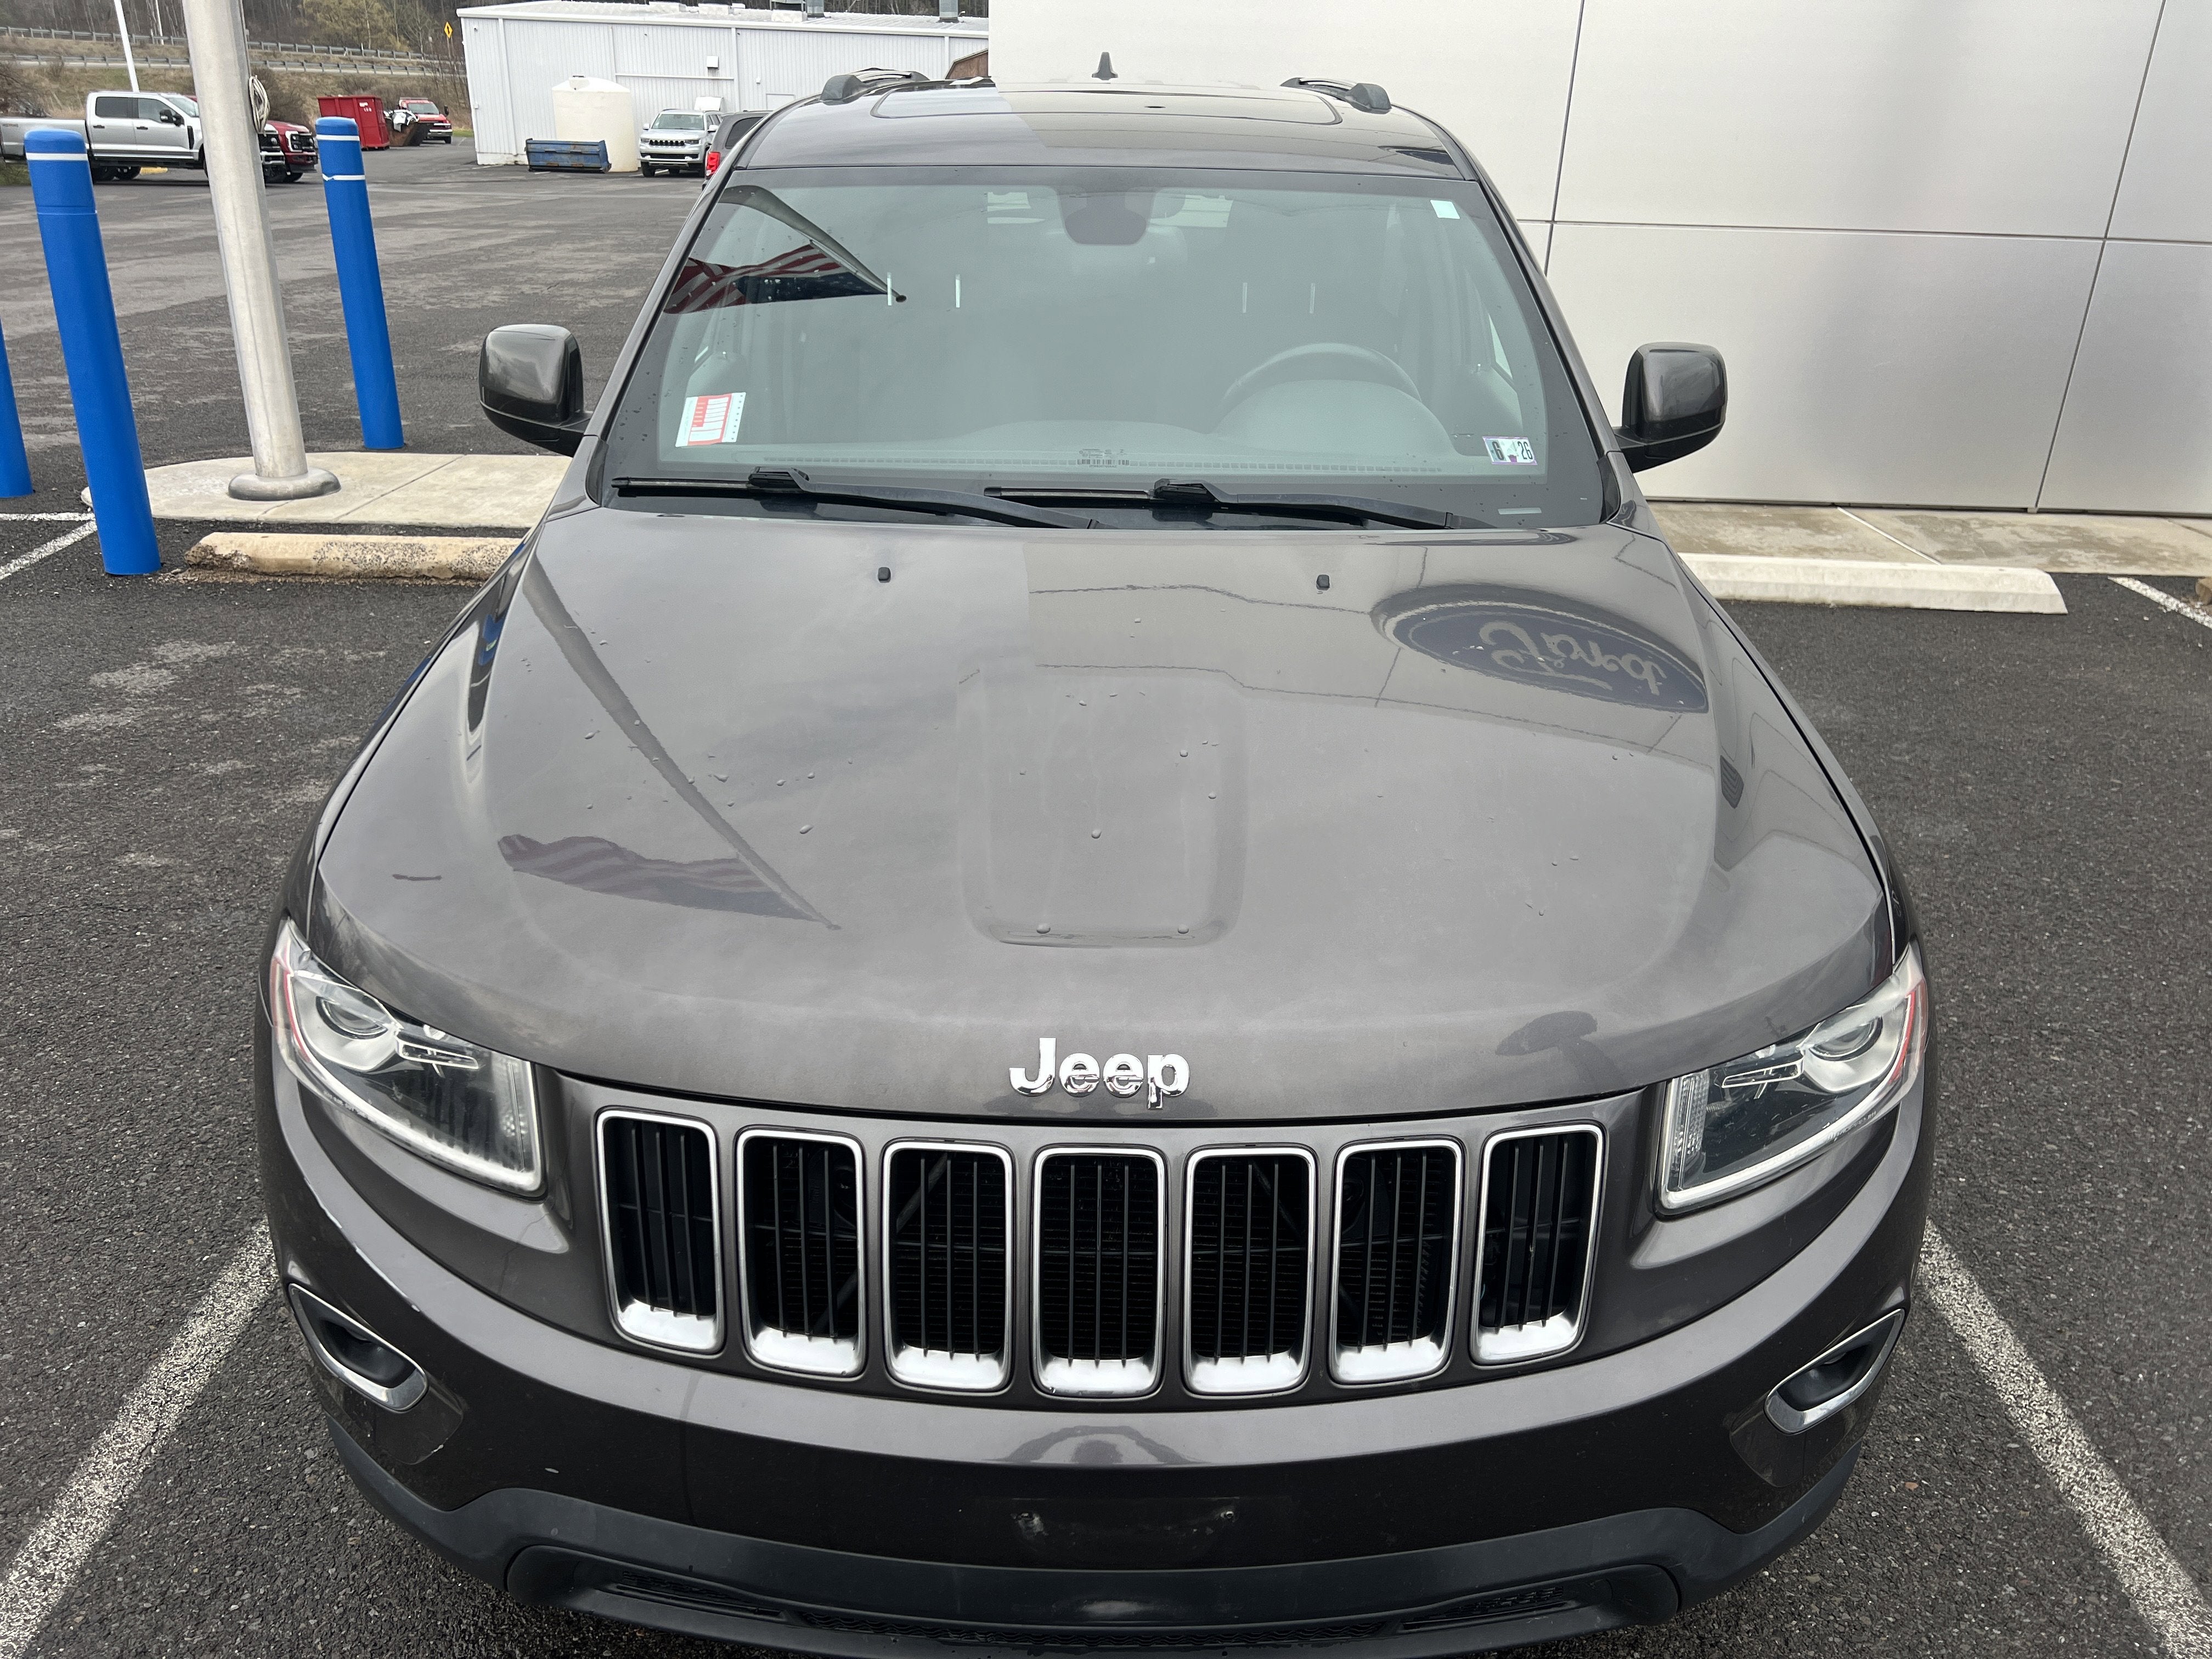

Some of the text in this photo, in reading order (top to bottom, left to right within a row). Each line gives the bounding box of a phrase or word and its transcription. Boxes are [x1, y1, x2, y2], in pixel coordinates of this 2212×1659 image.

[1492, 441, 1533, 460] 6 26
[1009, 1038, 1190, 1110] Jeep
